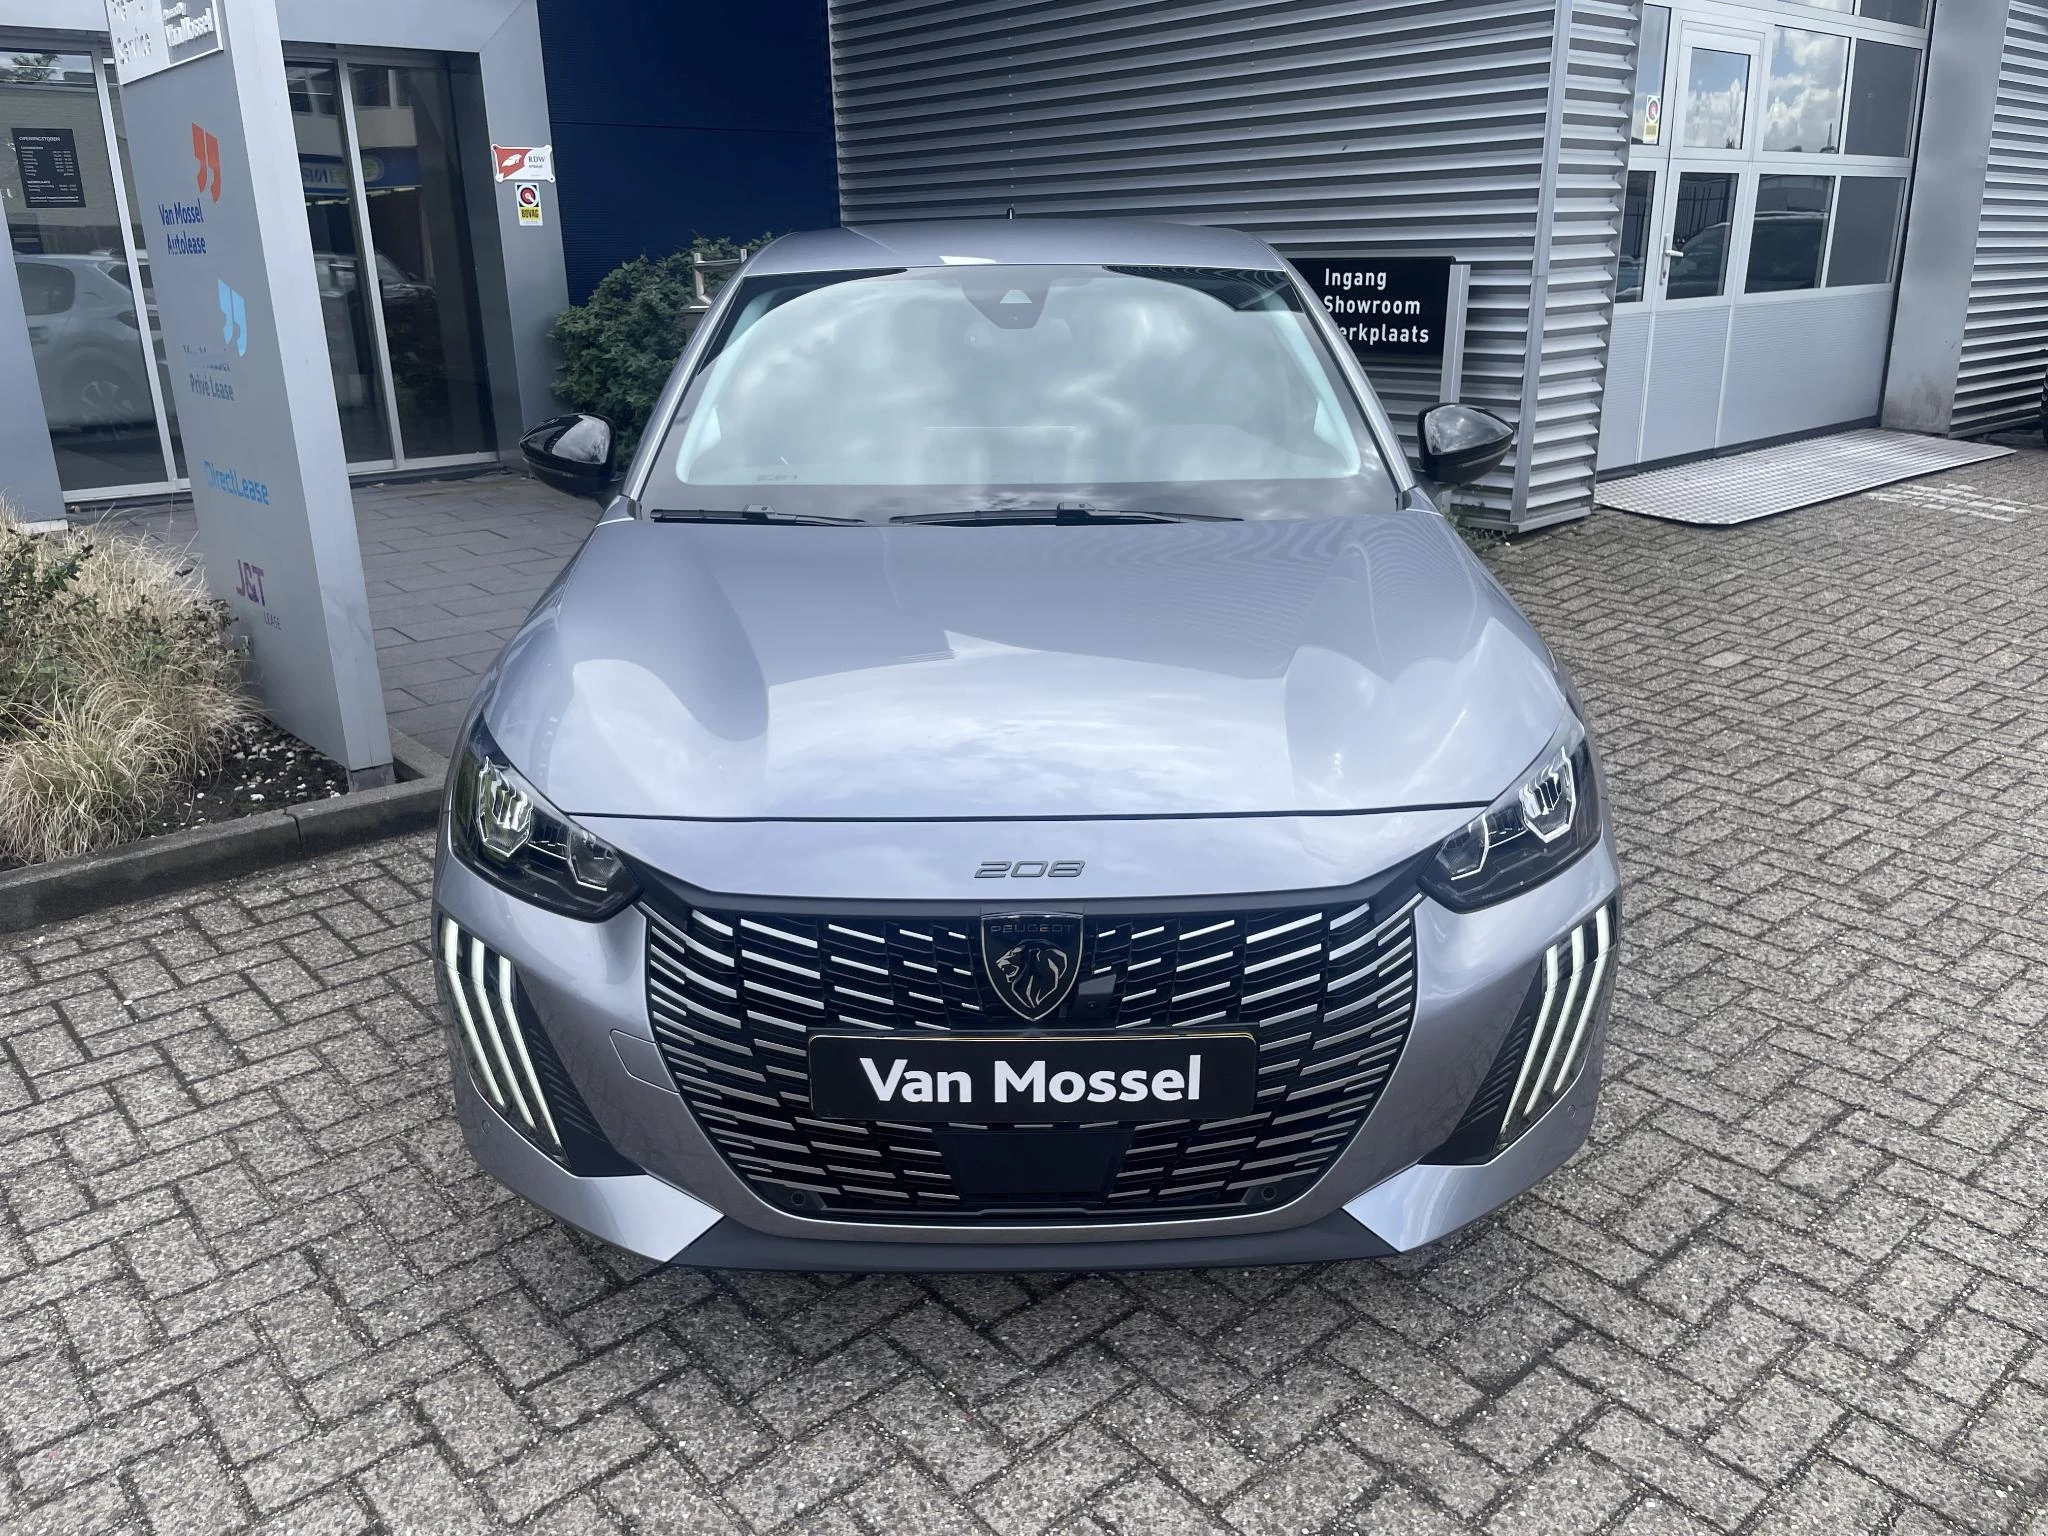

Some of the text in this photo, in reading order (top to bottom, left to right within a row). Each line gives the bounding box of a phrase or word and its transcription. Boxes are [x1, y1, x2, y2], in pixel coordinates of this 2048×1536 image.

[528, 155, 546, 163] RDW
[158, 197, 204, 226] Van Mossel
[521, 208, 539, 219] BOVAG
[167, 230, 207, 255] Autolease
[1325, 268, 1387, 291] Ingang
[1323, 295, 1421, 315] Showroom
[1338, 322, 1429, 346] erkplaats
[209, 375, 234, 401] Lease
[204, 460, 270, 506] DirectLease
[263, 612, 282, 631] LEASE
[974, 860, 1086, 879] 208
[990, 923, 1074, 934] PEUGEOT
[859, 1054, 1202, 1103] Van Mossel
